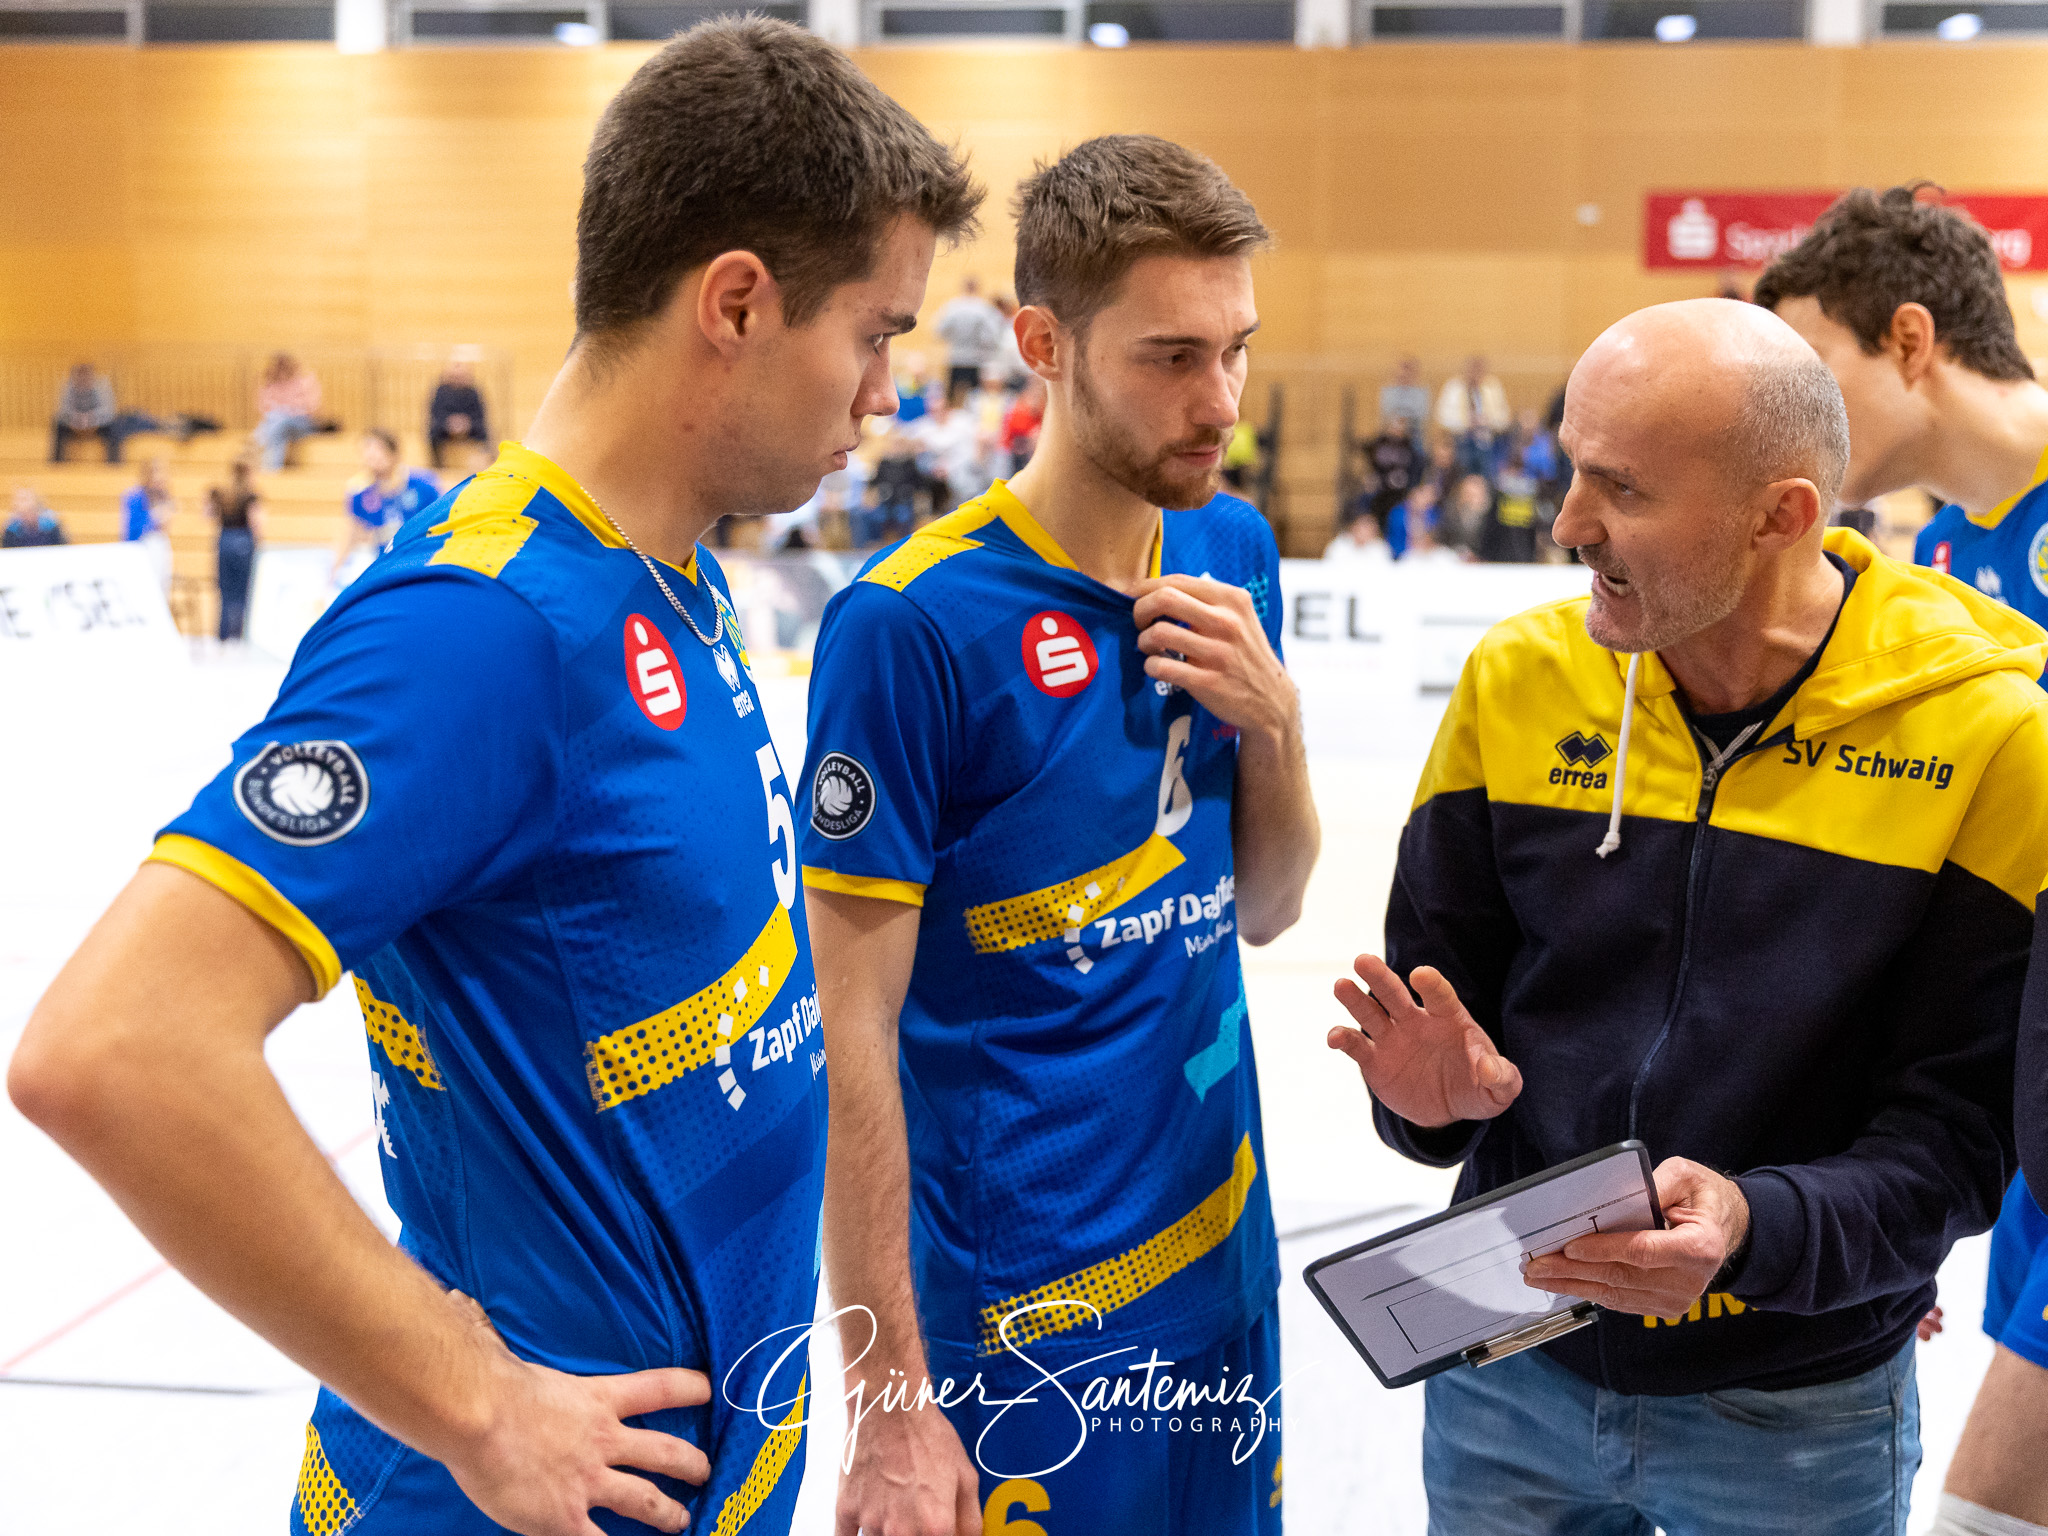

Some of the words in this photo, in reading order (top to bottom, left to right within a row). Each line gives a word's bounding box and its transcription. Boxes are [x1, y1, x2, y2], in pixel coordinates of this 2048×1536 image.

[1156, 715, 1193, 837] 6
[1549, 766, 1607, 790] errea
[1782, 739, 1827, 767] SV
[1835, 744, 1954, 790] Schwaig
[755, 742, 796, 910] 5
[1094, 897, 1175, 949] Zapf
[748, 1001, 803, 1072] Zapf
